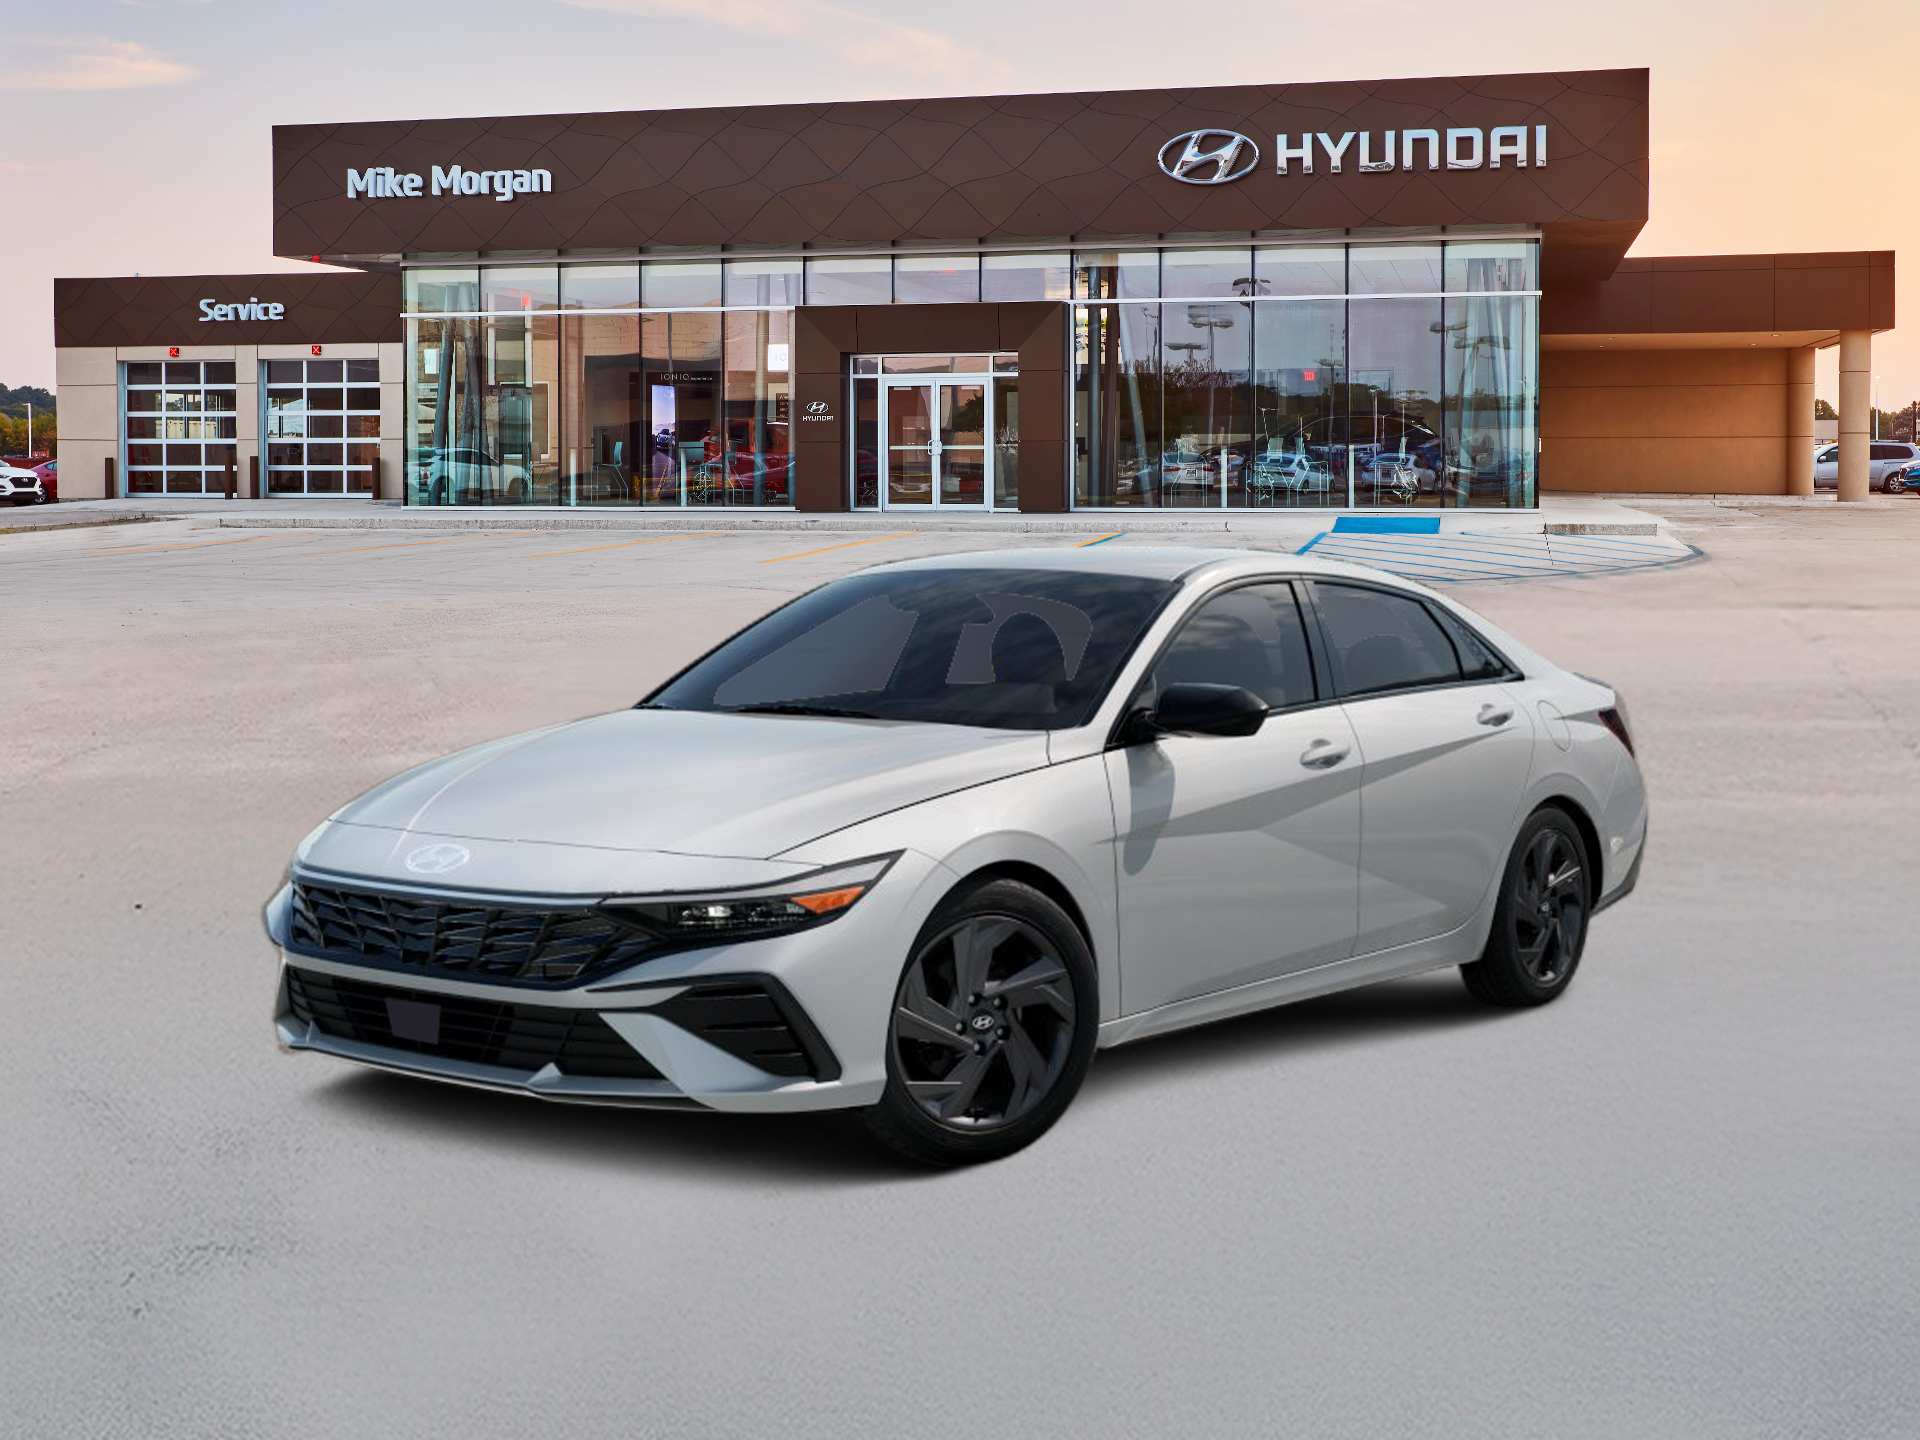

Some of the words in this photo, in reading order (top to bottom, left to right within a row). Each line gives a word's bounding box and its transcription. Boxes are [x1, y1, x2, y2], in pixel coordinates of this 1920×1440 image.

[1276, 125, 1547, 175] HYUNDAI
[346, 166, 424, 199] Mike
[431, 164, 552, 202] Morgan
[198, 296, 285, 322] Service
[660, 373, 690, 381] IONIQ
